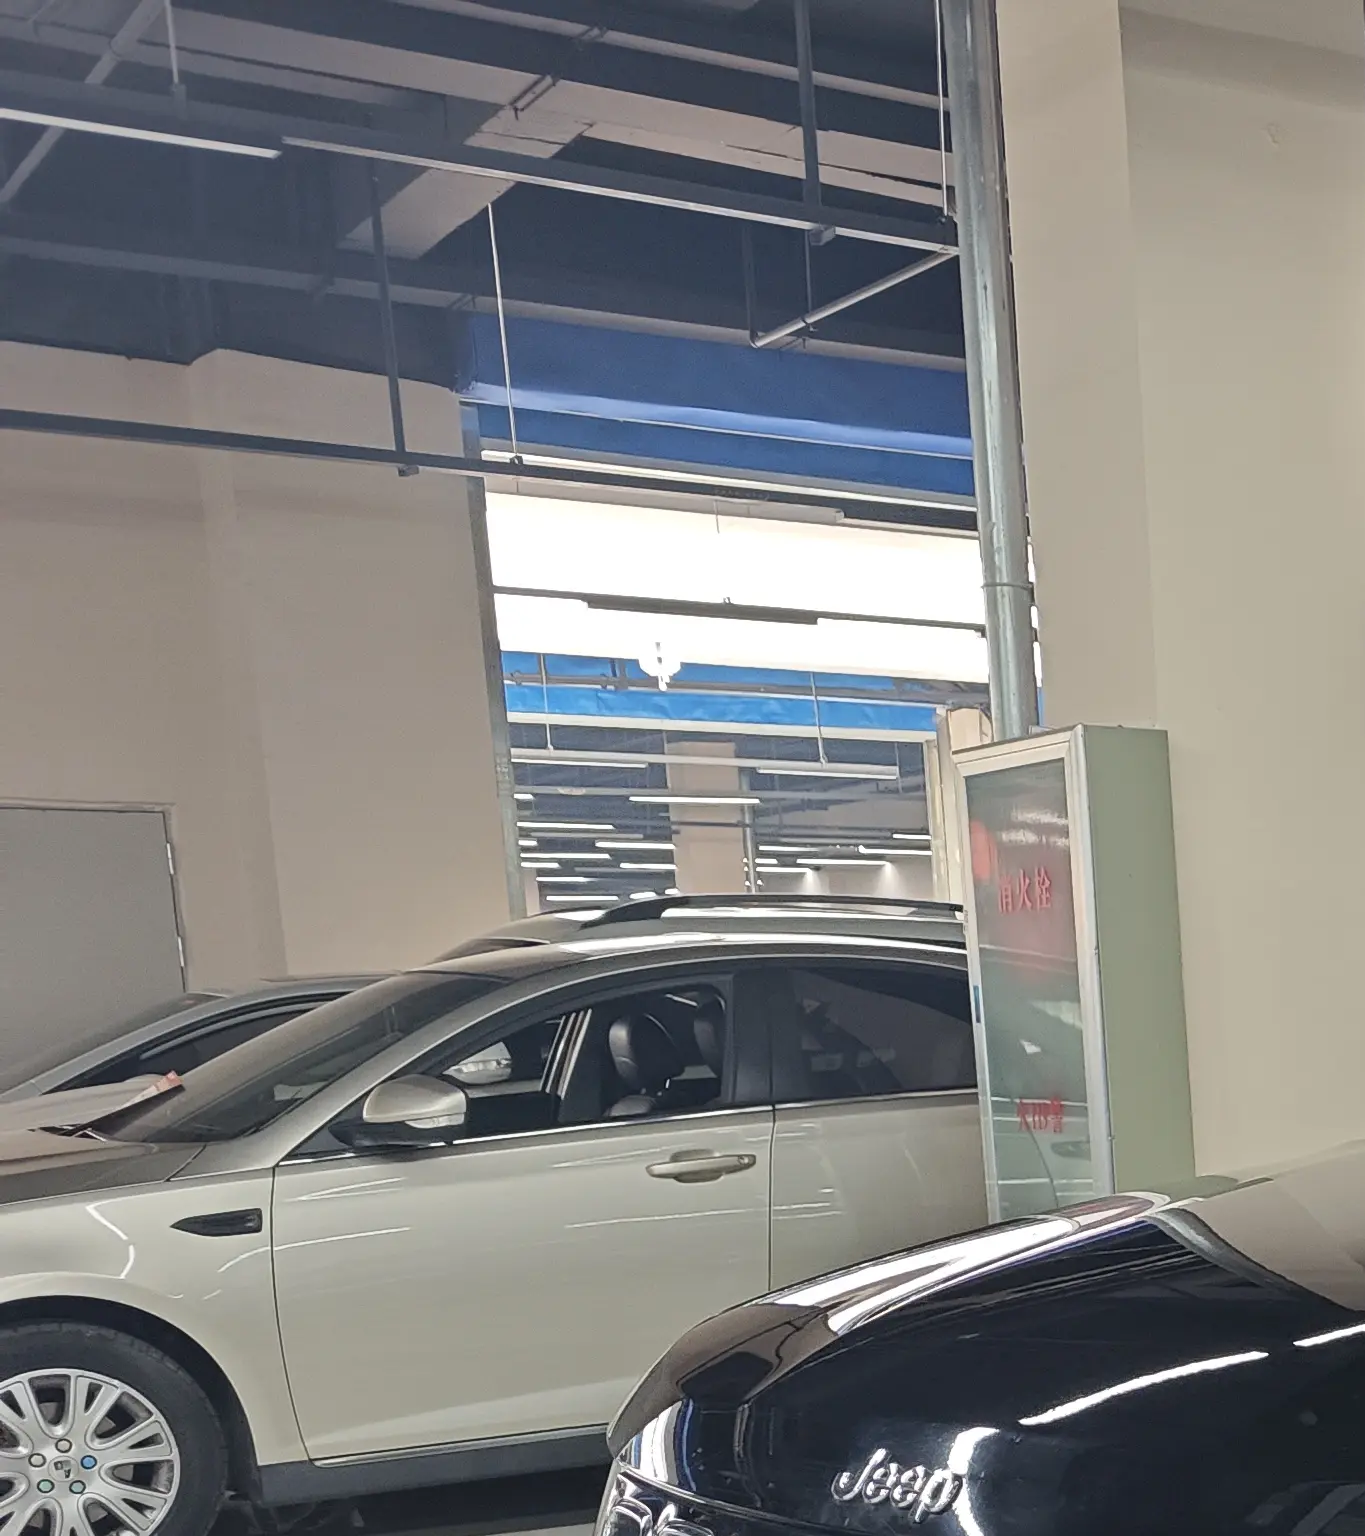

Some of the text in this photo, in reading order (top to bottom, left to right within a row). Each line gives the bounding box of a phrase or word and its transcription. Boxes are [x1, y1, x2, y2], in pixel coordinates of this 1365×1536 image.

[998, 866, 1052, 914] 消火栓
[831, 1448, 963, 1523] Jeep
